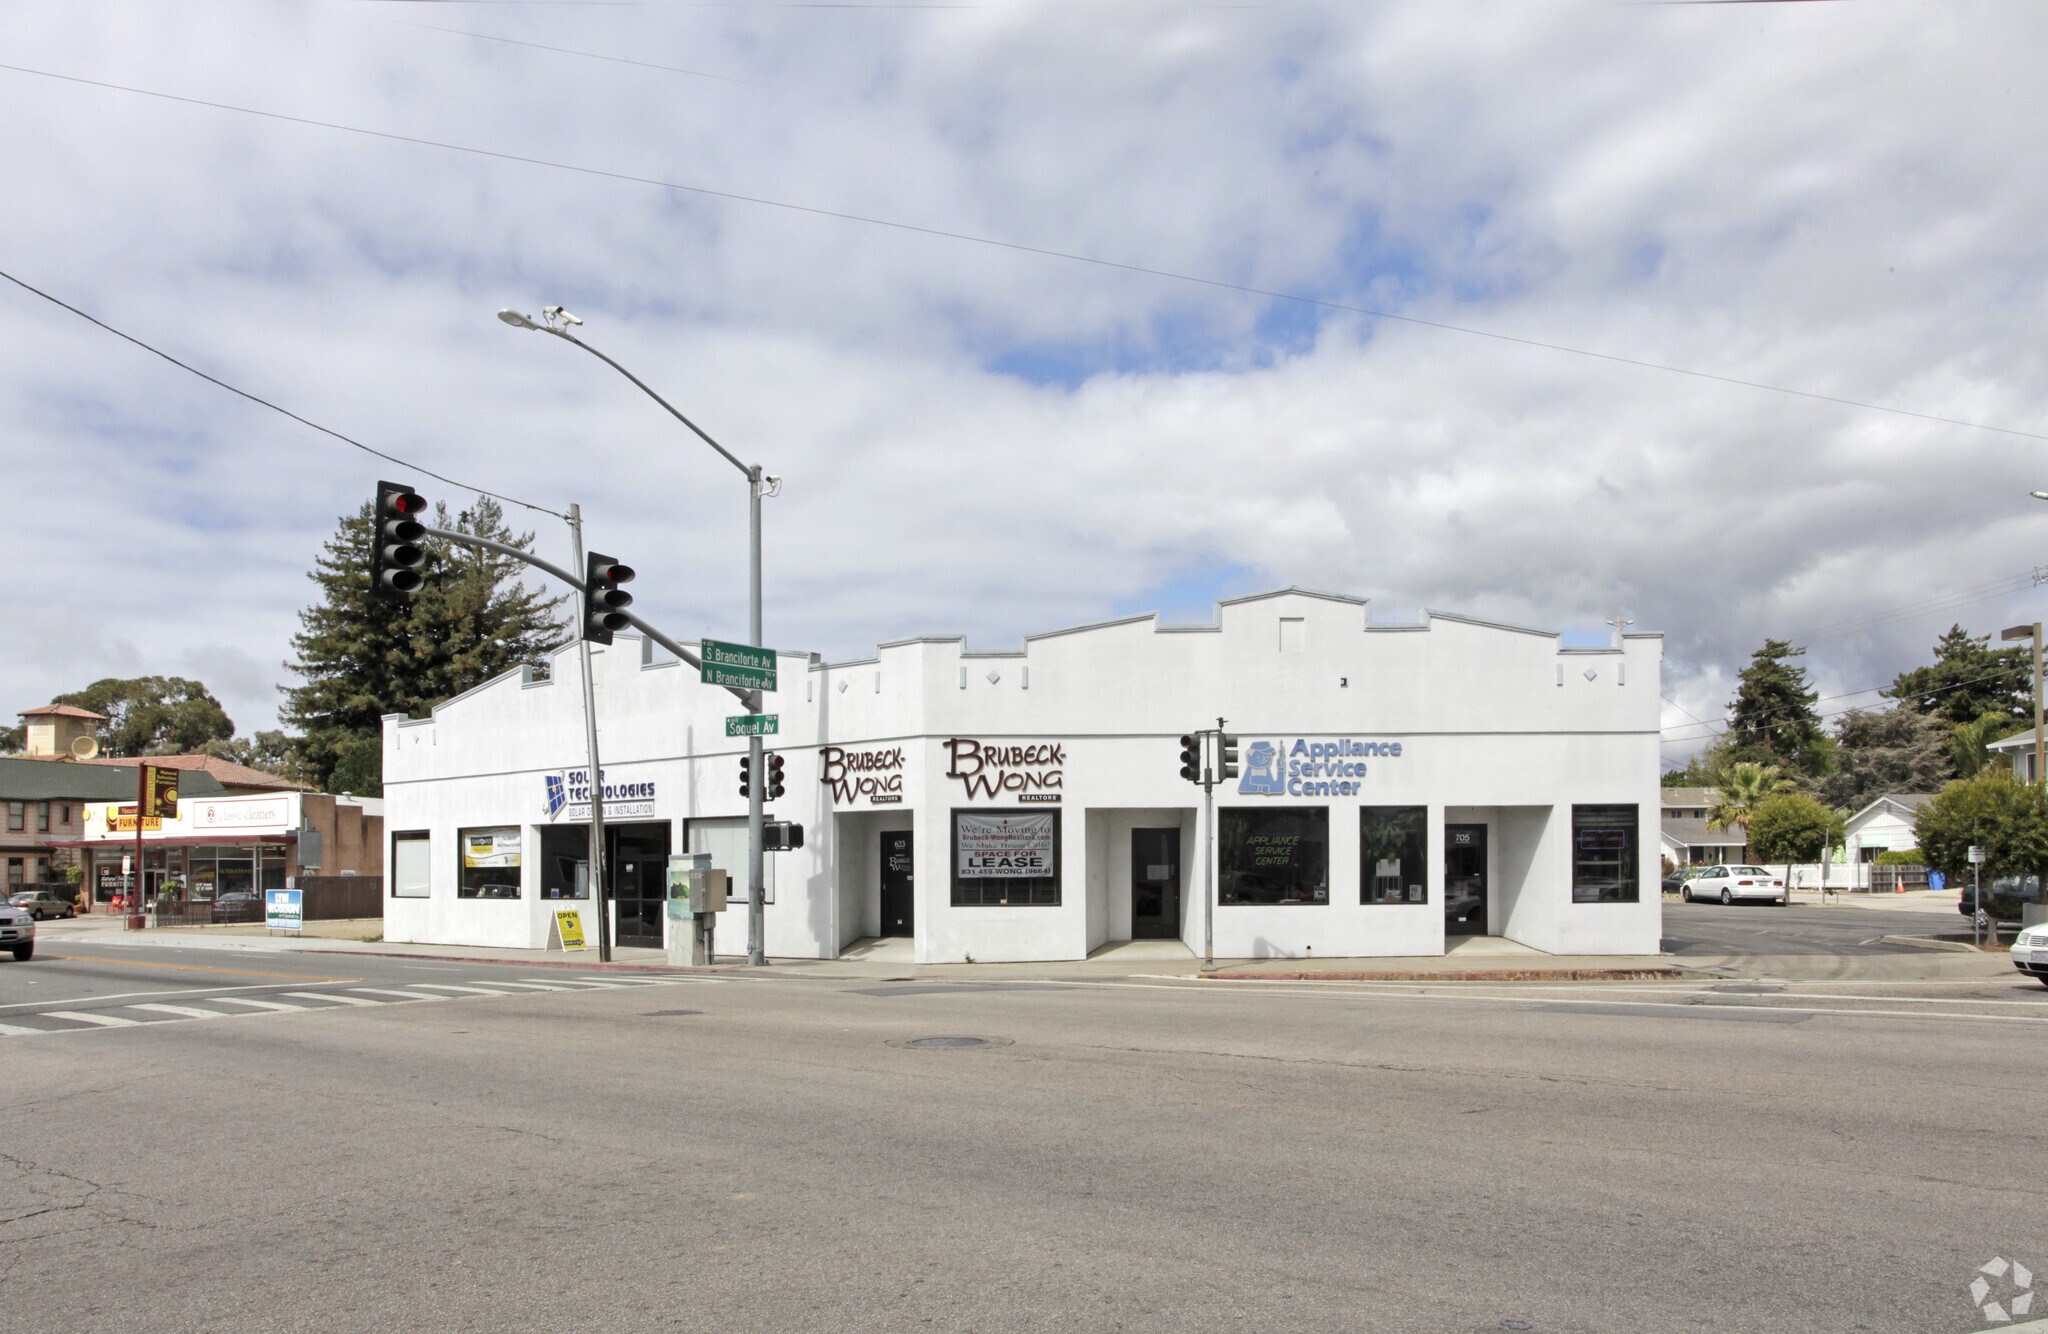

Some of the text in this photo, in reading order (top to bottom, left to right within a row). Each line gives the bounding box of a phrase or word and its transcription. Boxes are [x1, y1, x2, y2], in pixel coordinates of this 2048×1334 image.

[706, 647, 771, 668] S Branciforte Av
[706, 669, 773, 689] N Branciforte Av
[729, 721, 774, 736] Soquel Av
[1289, 739, 1402, 763] Appliance
[1288, 758, 1367, 777] Service
[569, 769, 605, 785] SOLR
[568, 782, 655, 801] TECNOLOGIES
[830, 774, 903, 805] WONG
[960, 770, 1063, 801] WONG
[1287, 777, 1361, 797] Center
[244, 807, 276, 820] cleaners
[569, 807, 585, 817] SOLAR
[614, 803, 653, 815] INSTALLATION
[119, 817, 159, 828] FURNTURE
[961, 825, 1051, 835] We're Moving to
[1246, 836, 1300, 846] APPLIANCE
[1455, 834, 1470, 842] 705
[1255, 846, 1292, 855] SERVICE
[968, 857, 1043, 868] LEASE
[1255, 856, 1290, 865] CENTER
